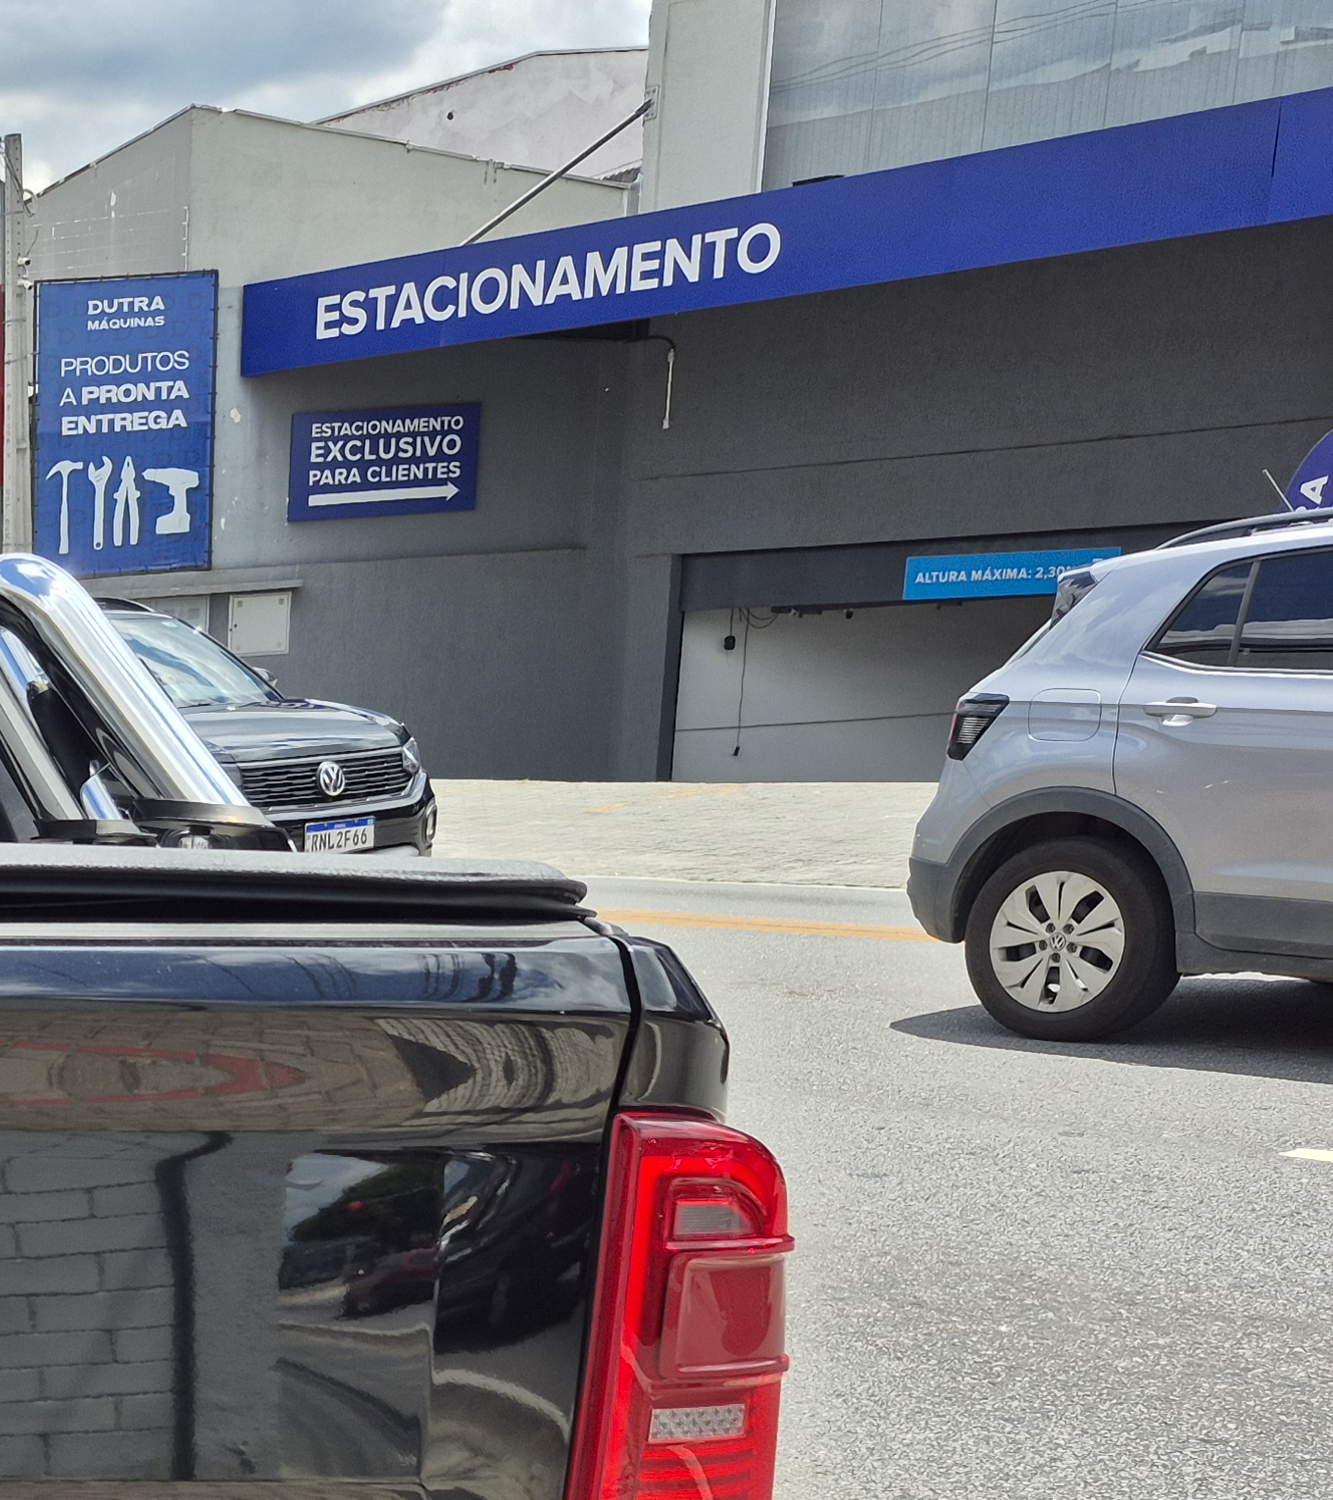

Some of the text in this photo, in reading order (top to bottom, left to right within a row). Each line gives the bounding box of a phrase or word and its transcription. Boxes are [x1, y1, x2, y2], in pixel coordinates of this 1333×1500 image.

[316, 222, 782, 340] ESTACIONAMENTO
[87, 296, 166, 315] DUTRA
[87, 315, 165, 331] MÁQUINAS
[60, 350, 190, 377] PRODUTOS
[59, 380, 190, 407] A PRONTA
[61, 409, 188, 436] ENTREGA
[311, 415, 464, 438] ESTACIONAMENTO
[310, 433, 462, 463] EXCLUSIVO
[308, 461, 461, 486] PARA CLIENTES
[915, 570, 968, 584] ALTURA
[970, 566, 1033, 582] MÁXIMA:
[311, 828, 367, 852] RNL2F66
